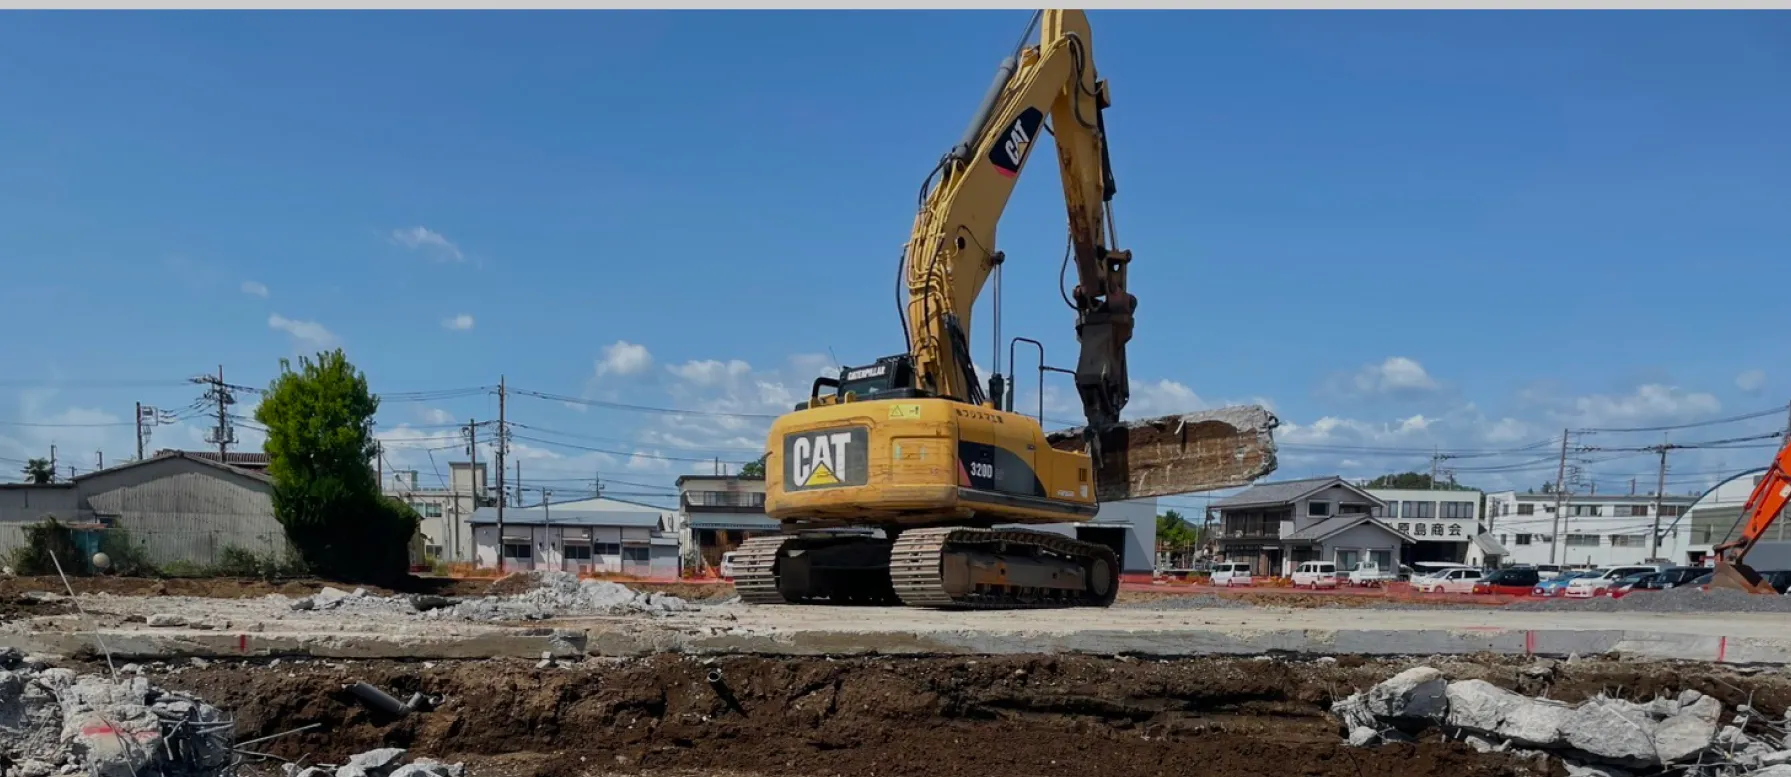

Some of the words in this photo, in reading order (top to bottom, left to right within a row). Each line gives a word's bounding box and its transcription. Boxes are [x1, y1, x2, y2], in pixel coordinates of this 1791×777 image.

[1005, 119, 1030, 166] CAT
[793, 432, 852, 487] CAT
[970, 461, 993, 479] 320D
